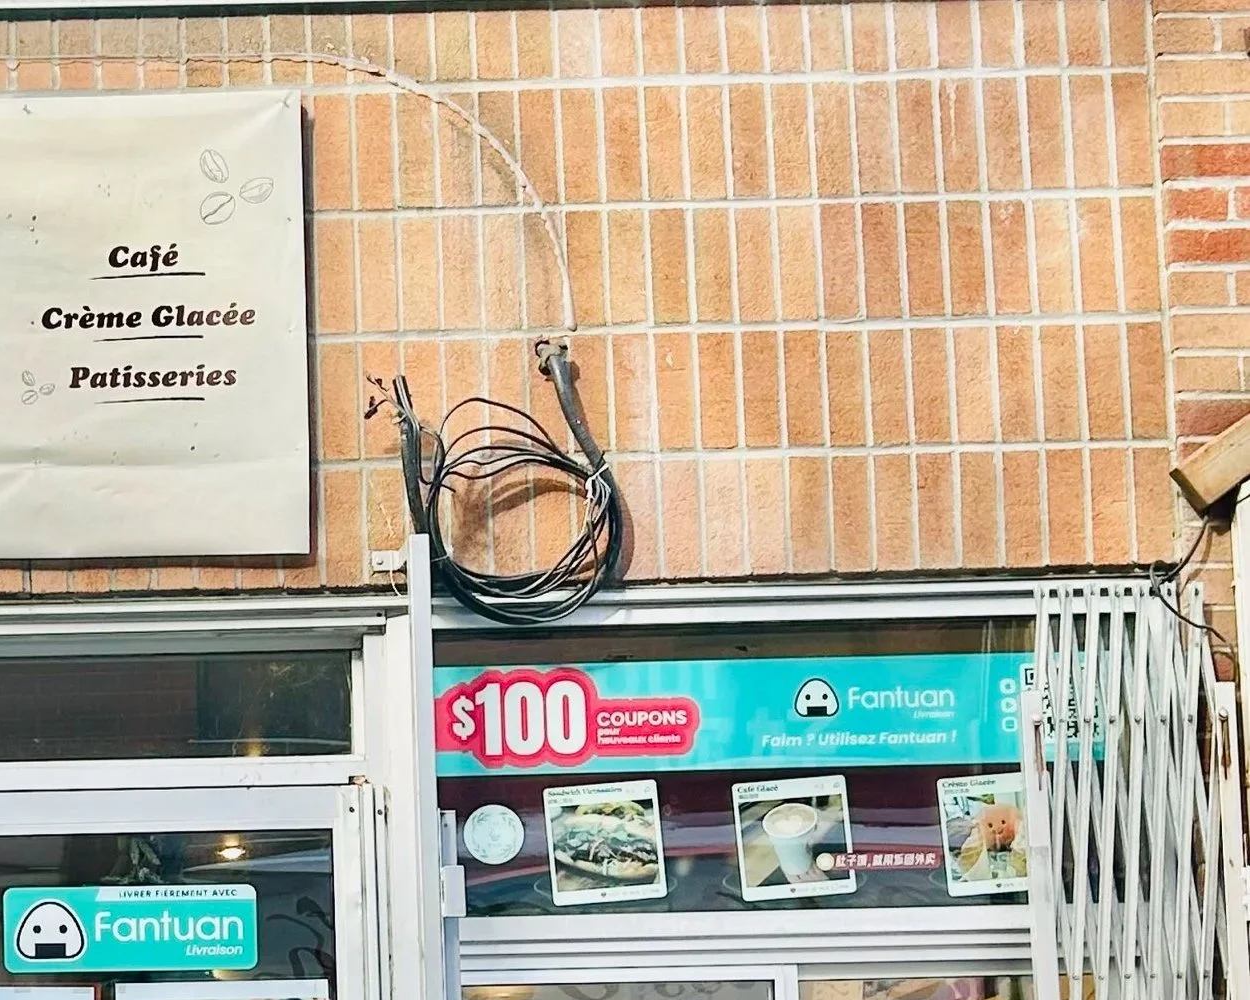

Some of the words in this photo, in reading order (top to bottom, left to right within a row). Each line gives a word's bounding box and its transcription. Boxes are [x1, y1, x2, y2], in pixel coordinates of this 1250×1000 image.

[108, 242, 179, 271] Café
[42, 305, 141, 330] Crème
[151, 304, 256, 330] Glacée
[69, 364, 238, 390] Patisseries
[847, 687, 955, 709] Fantuan
[452, 680, 588, 756] $100
[597, 710, 687, 727] COUPONS
[762, 734, 802, 747] Faim
[818, 732, 875, 746] Utilisez
[879, 731, 948, 745] Fantuan
[119, 889, 152, 898] LIVRER
[212, 888, 238, 897] AVEC
[95, 911, 243, 942] Fantuan
[186, 944, 244, 956] Livraison
